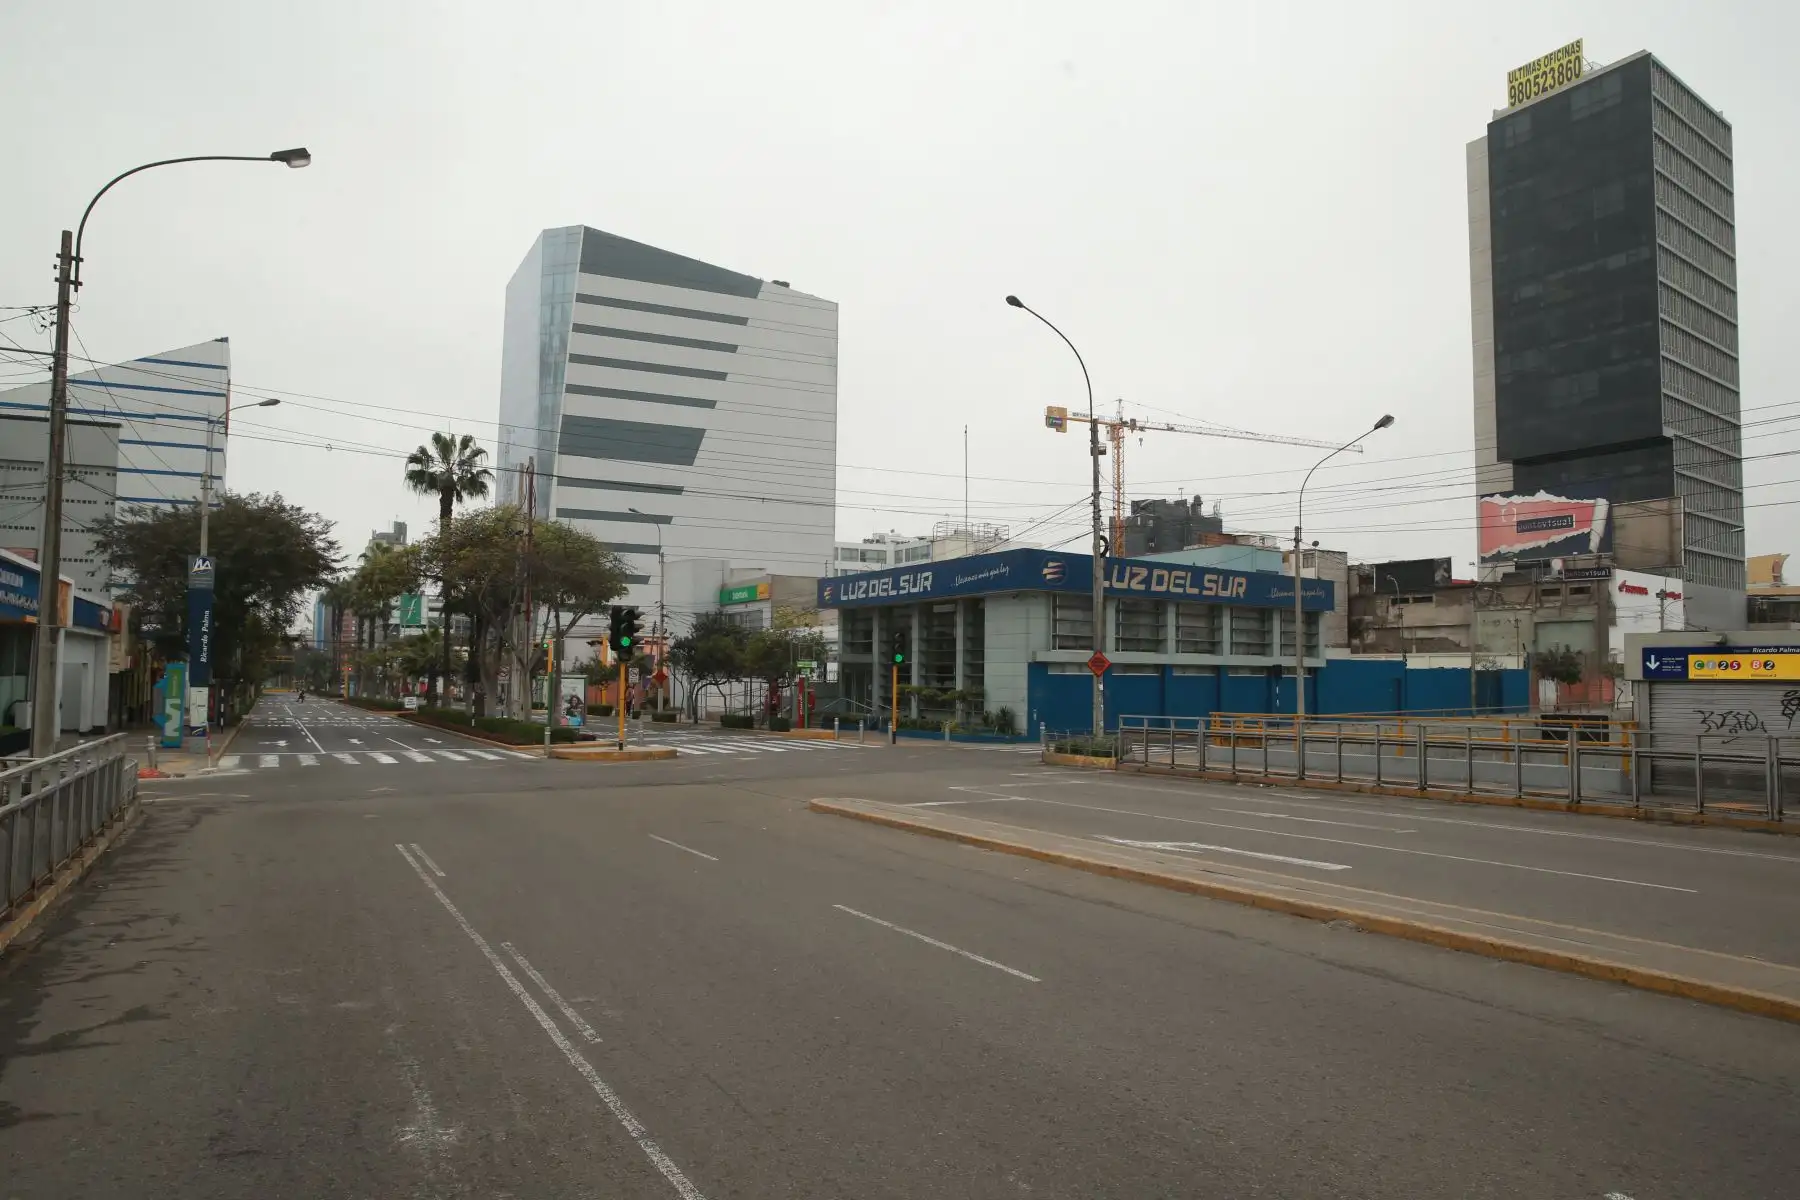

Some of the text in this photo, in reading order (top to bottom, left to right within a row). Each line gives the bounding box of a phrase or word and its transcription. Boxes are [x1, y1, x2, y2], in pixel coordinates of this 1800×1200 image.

[1508, 40, 1581, 84] ULTIMAS OFICINAS
[1509, 55, 1581, 107] 980523860
[1517, 516, 1573, 531] puntovisual
[840, 571, 933, 601] LUZ DEL SUR
[1150, 568, 1200, 595] DEL
[1202, 574, 1247, 599] SUR
[200, 610, 210, 663] Ricardo Palma
